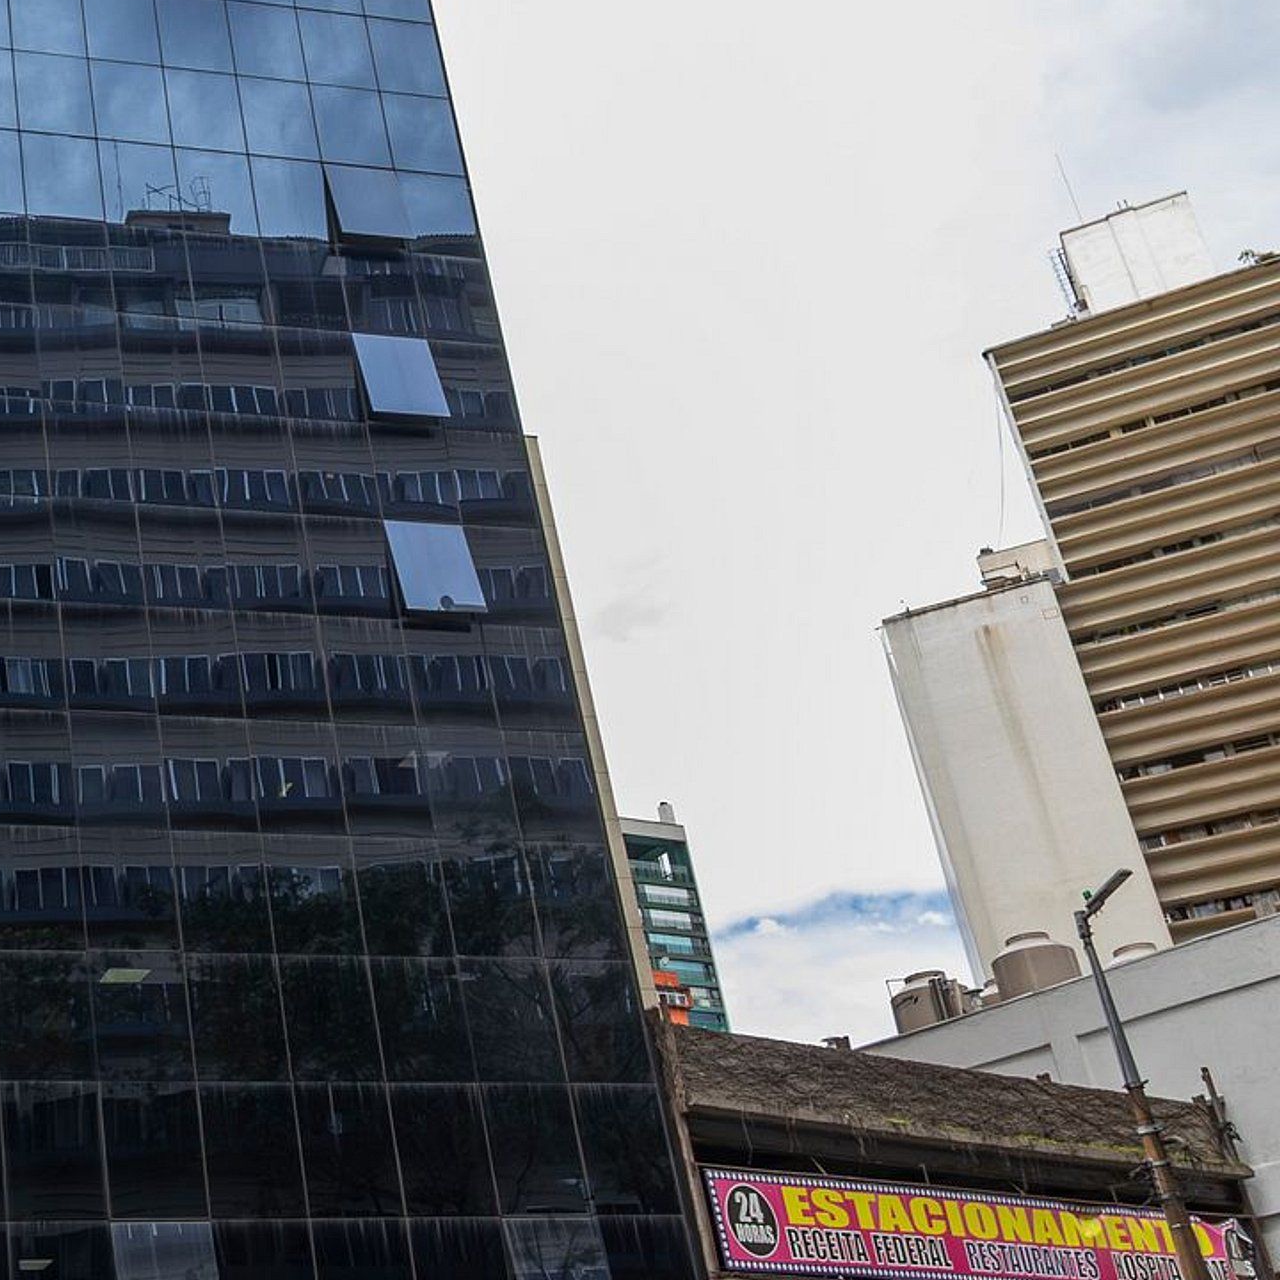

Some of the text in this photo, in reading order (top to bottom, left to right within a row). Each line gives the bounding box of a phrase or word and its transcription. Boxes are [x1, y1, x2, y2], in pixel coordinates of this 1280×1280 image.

[734, 1191, 765, 1223] 24
[734, 1222, 776, 1245] HORAS
[786, 1227, 870, 1263] RECEITA
[871, 1233, 954, 1269] FEDERAL
[964, 1240, 1101, 1280] RESTAURANTES
